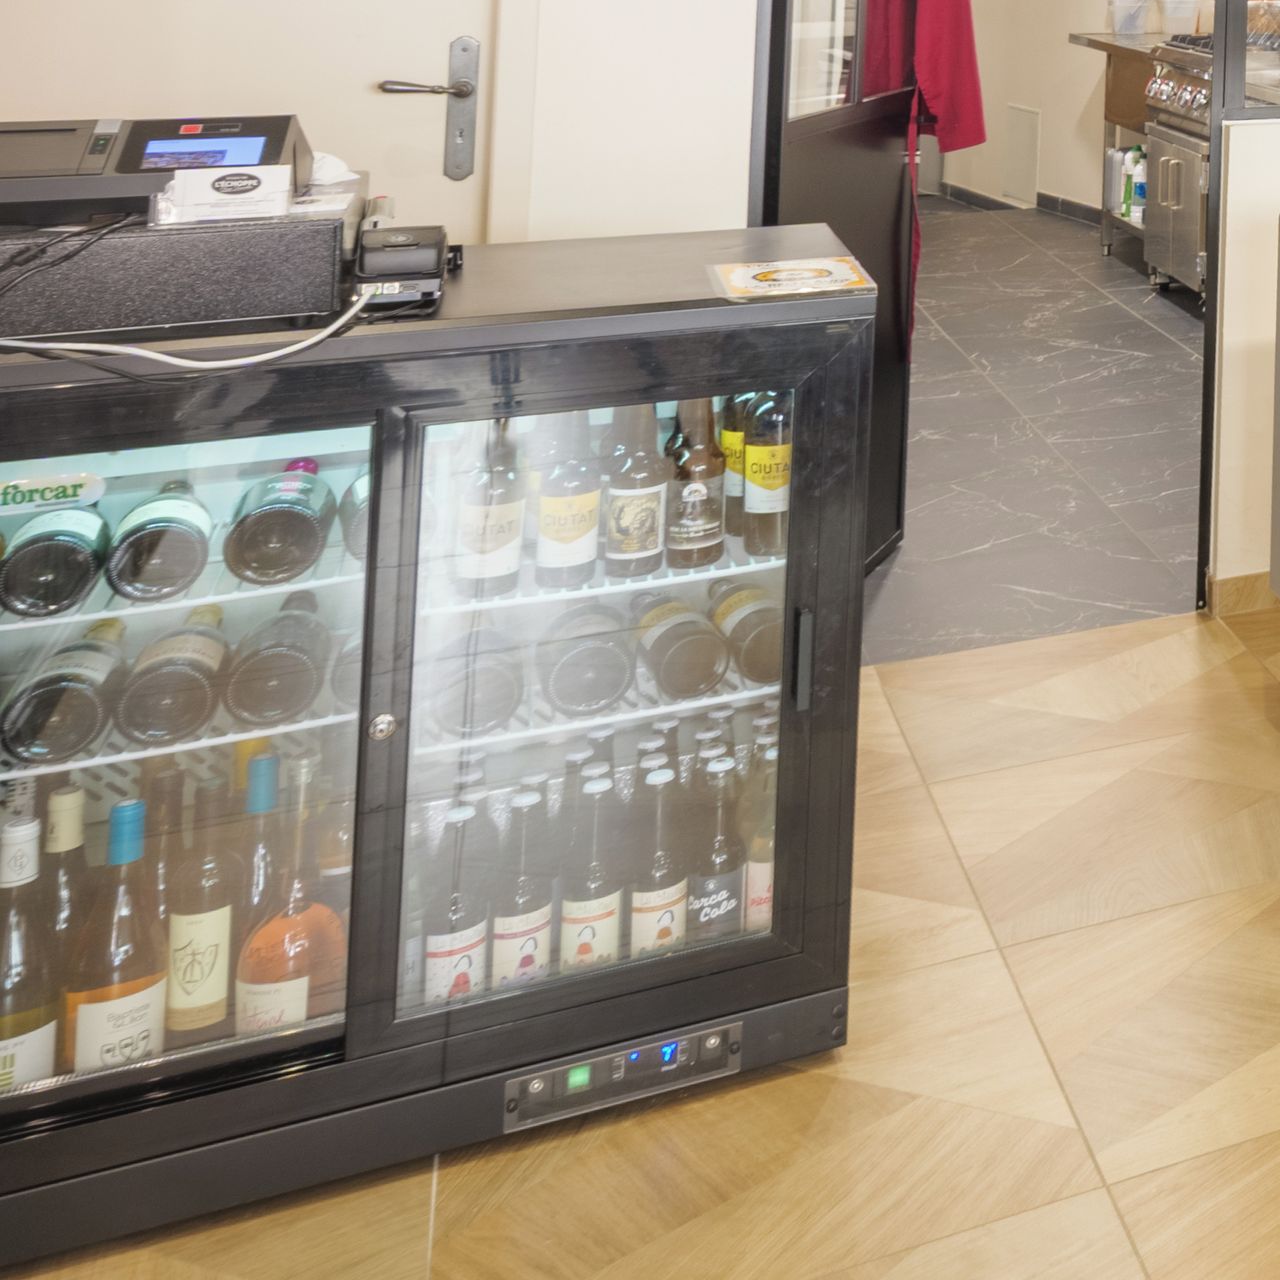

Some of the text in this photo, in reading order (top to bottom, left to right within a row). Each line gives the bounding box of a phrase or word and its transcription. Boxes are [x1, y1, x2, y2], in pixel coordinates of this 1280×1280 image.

[751, 462, 790, 475] CIUTA
[1, 481, 84, 505] forcar
[544, 510, 595, 526] CIUTAT
[700, 899, 738, 922] Cola
